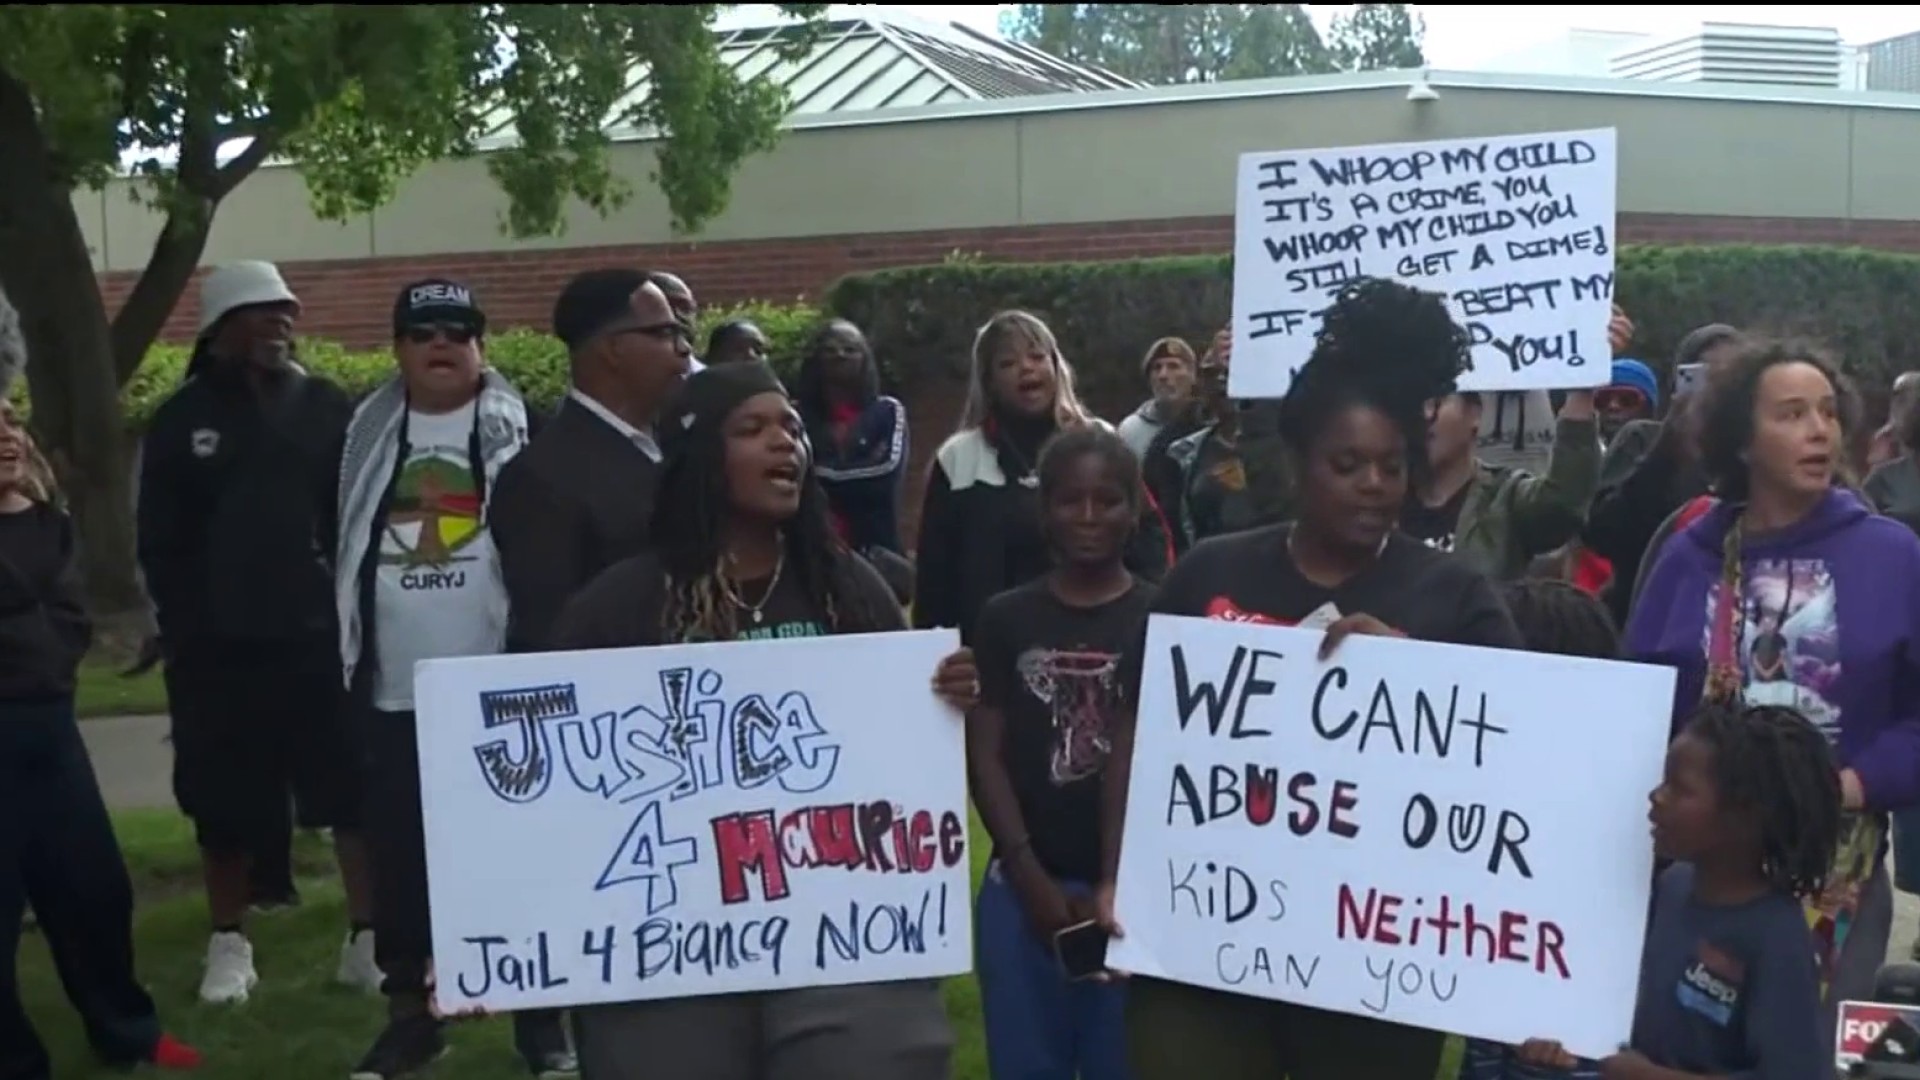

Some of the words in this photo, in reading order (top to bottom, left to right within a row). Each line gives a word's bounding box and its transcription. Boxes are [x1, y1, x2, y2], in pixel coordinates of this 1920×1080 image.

[1258, 160, 1297, 190] I
[1310, 150, 1434, 187] WHOOP
[1445, 144, 1489, 175] MY
[1494, 140, 1596, 170] CHILD
[1263, 193, 1334, 223] IT'S
[1351, 193, 1379, 219] A
[1492, 175, 1552, 201] YOU
[1264, 229, 1369, 263] WHOOP
[1379, 217, 1424, 249] MY
[1428, 209, 1516, 242] CHILD
[1517, 194, 1578, 230] YOU
[1397, 250, 1459, 278] GET
[1469, 244, 1495, 271] A
[1506, 225, 1607, 262] DIME!
[410, 284, 471, 304] DREAM
[1248, 309, 1308, 339] IF
[1453, 280, 1562, 317] BEAT
[1571, 272, 1615, 301] MY
[1492, 330, 1586, 373] YOU!
[400, 571, 466, 591] CURYJ
[1170, 644, 1284, 740] WE
[473, 667, 842, 804] Justice
[1166, 762, 1361, 839] ABUSE
[1402, 792, 1533, 879] OUR
[594, 800, 698, 916] 4
[583, 926, 616, 984] 4
[816, 883, 948, 971] NOW!
[1217, 942, 1320, 990] CAN
[1684, 962, 1737, 1004] Jeep
[1843, 1018, 1888, 1044] FO
